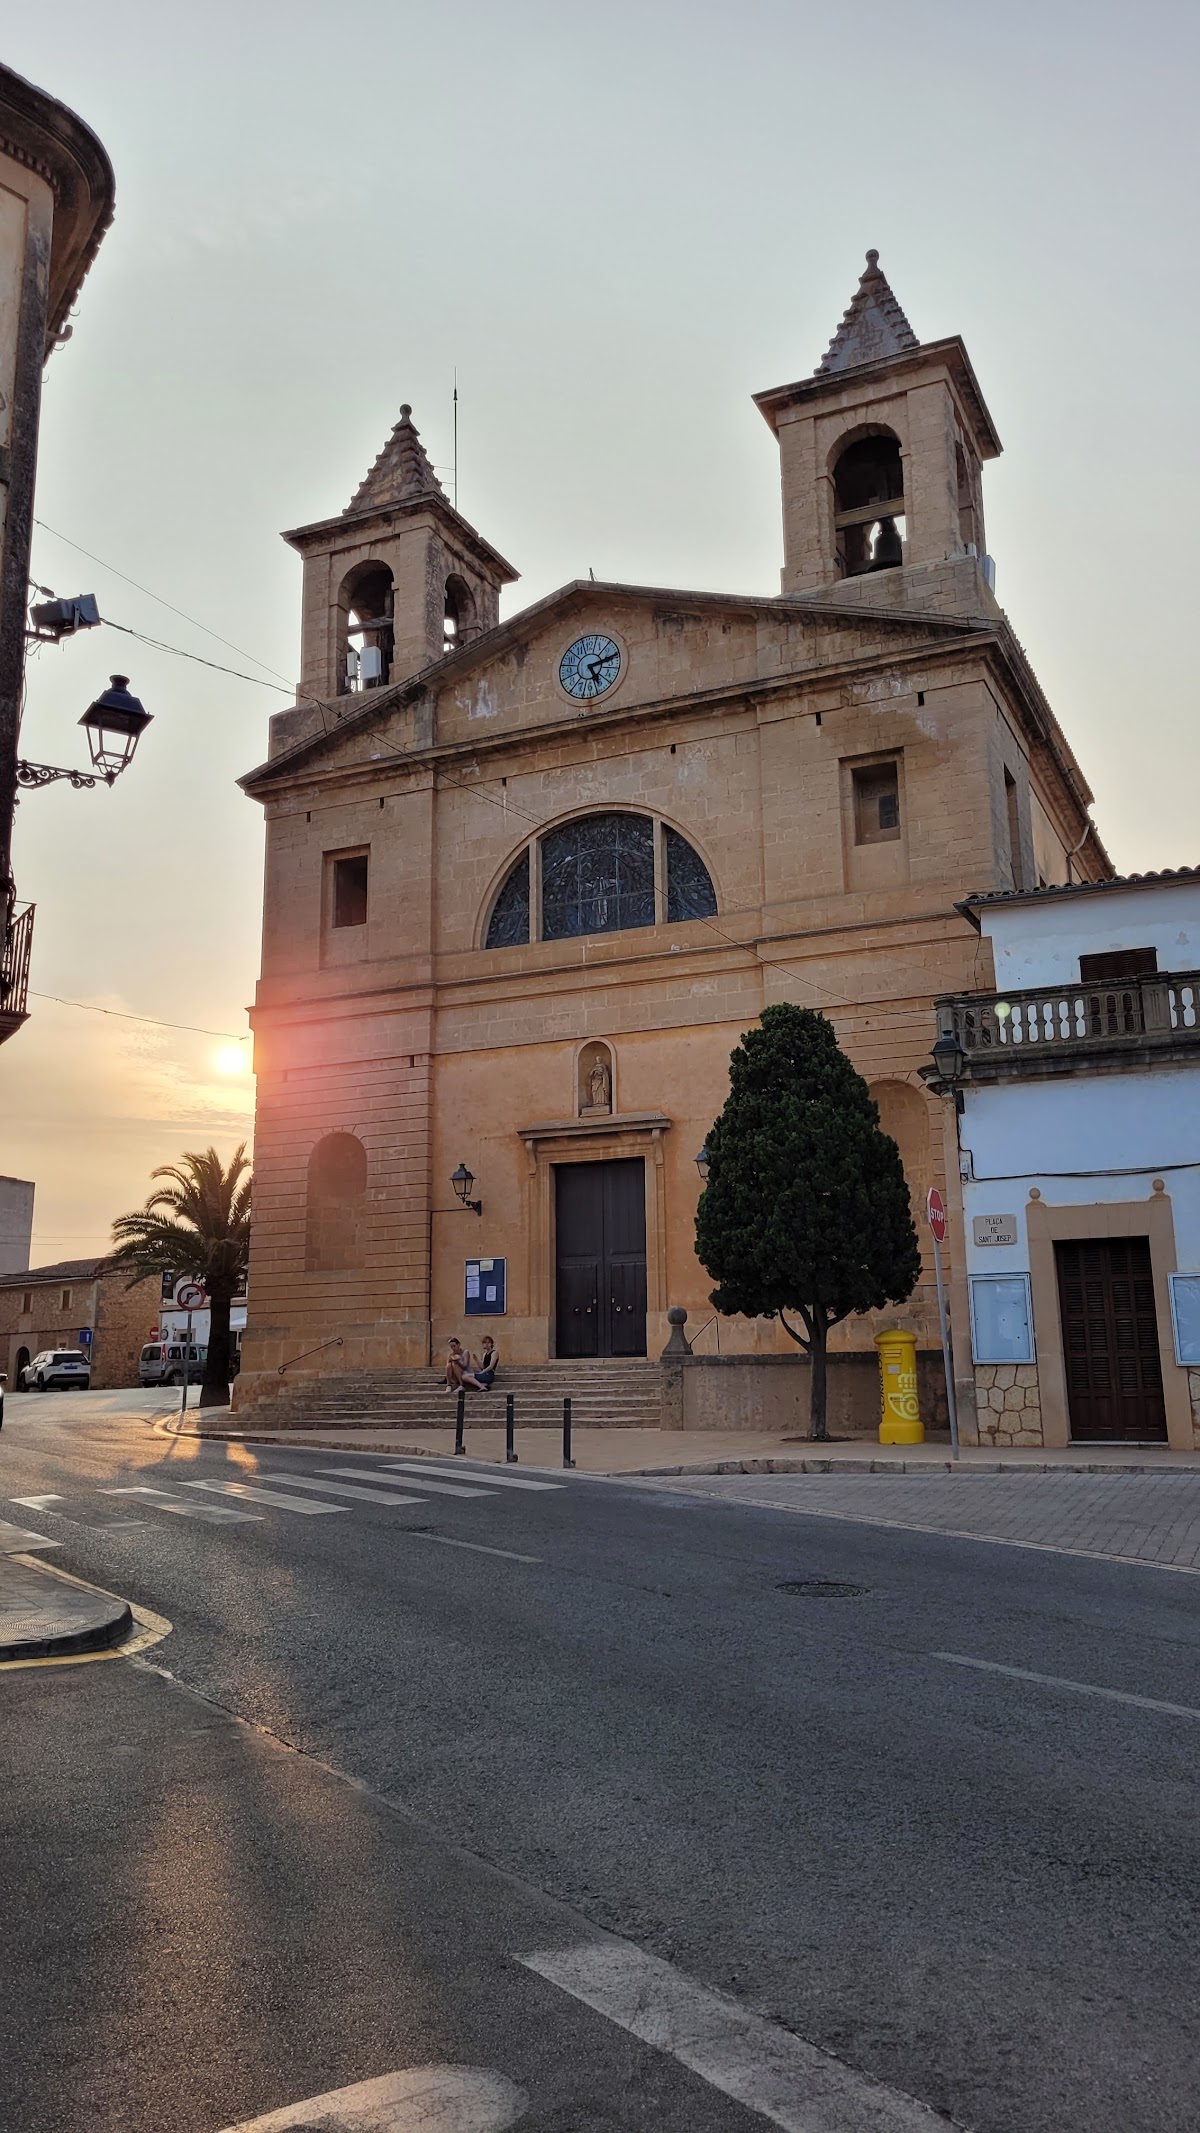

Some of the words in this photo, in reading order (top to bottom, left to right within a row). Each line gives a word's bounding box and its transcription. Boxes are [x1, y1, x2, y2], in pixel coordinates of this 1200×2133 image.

[577, 645, 583, 655] 11
[586, 641, 593, 651] 12
[568, 656, 576, 666] 10
[605, 669, 611, 678] 4
[570, 677, 575, 687] 8
[578, 682, 583, 691] 7
[588, 681, 593, 691] 6
[931, 1208, 943, 1222] STOP
